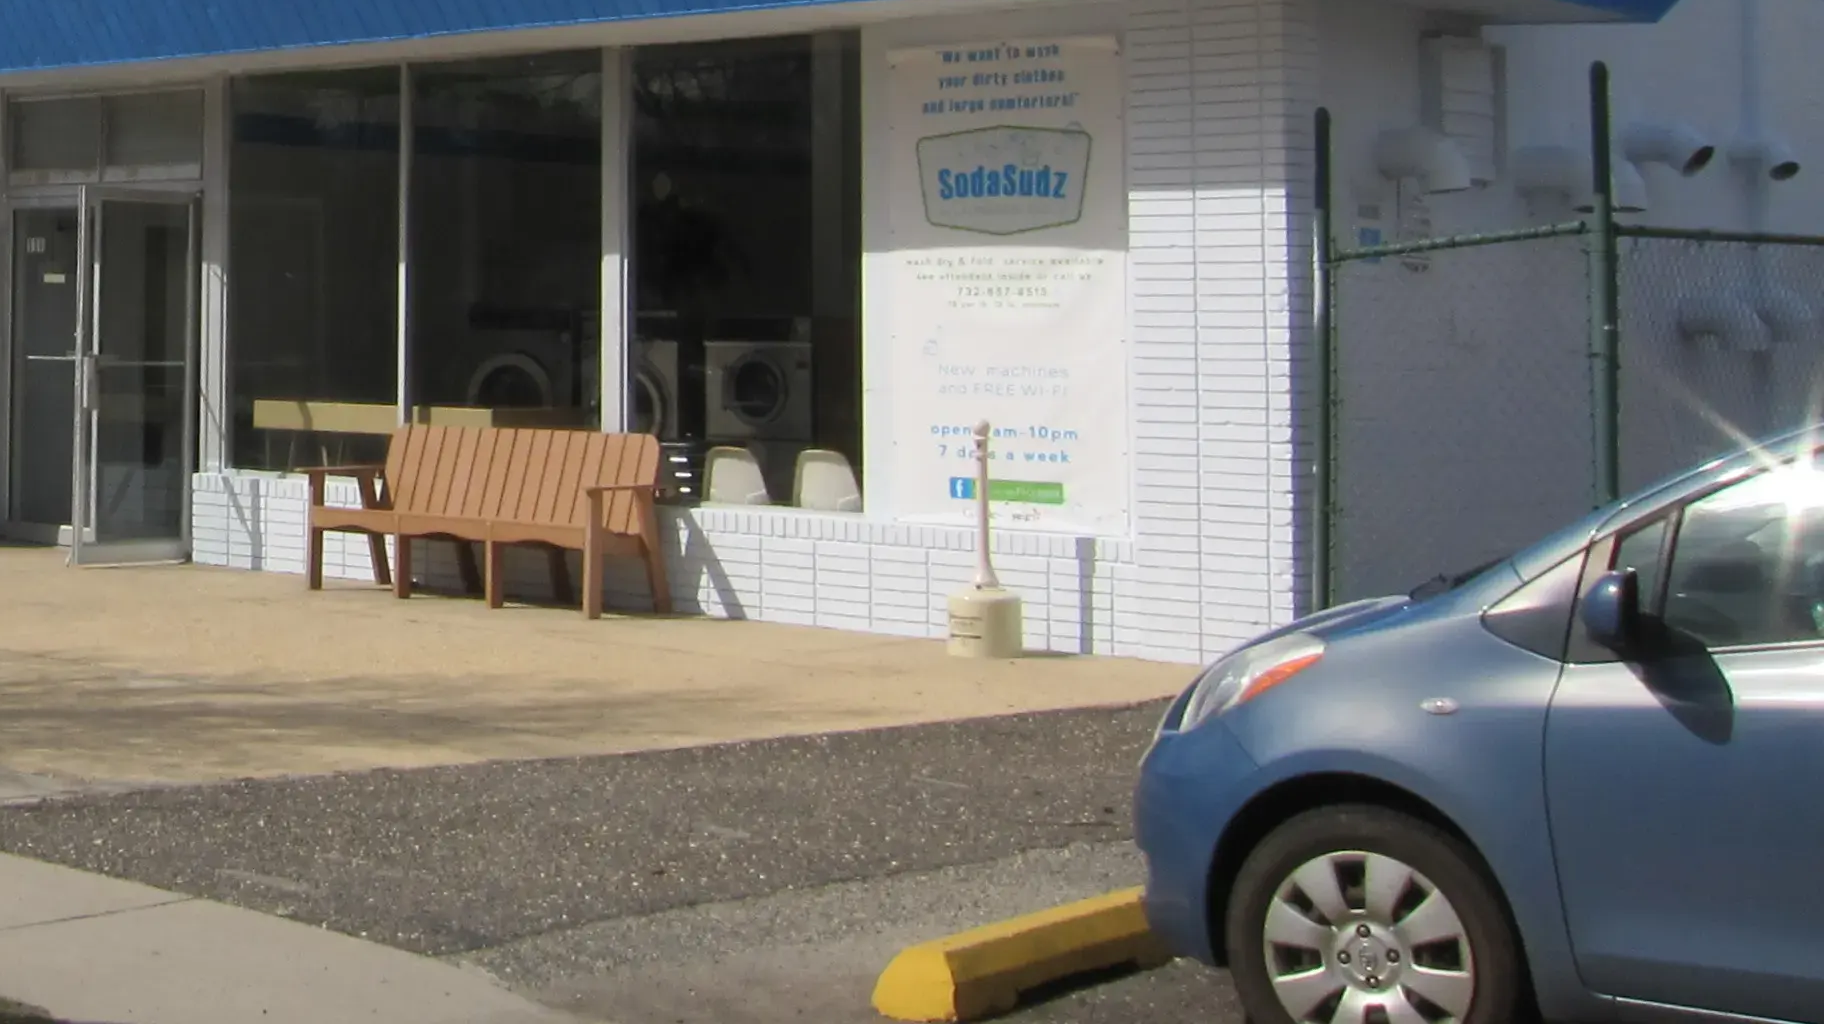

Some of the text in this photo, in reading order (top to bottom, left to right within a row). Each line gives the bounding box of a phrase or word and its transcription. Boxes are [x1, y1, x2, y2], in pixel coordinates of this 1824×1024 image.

[967, 48, 1001, 62] want
[1007, 46, 1020, 60] to
[1025, 43, 1060, 58] wash
[938, 69, 1065, 90] your dirty clothes
[922, 99, 944, 114] and
[949, 97, 984, 114] large
[938, 164, 1069, 201] SodaSudz
[938, 363, 1069, 379] New machines
[938, 383, 967, 395] and
[973, 382, 1016, 397] FREE
[931, 424, 972, 438] open
[939, 444, 1071, 464] 7 das a week
